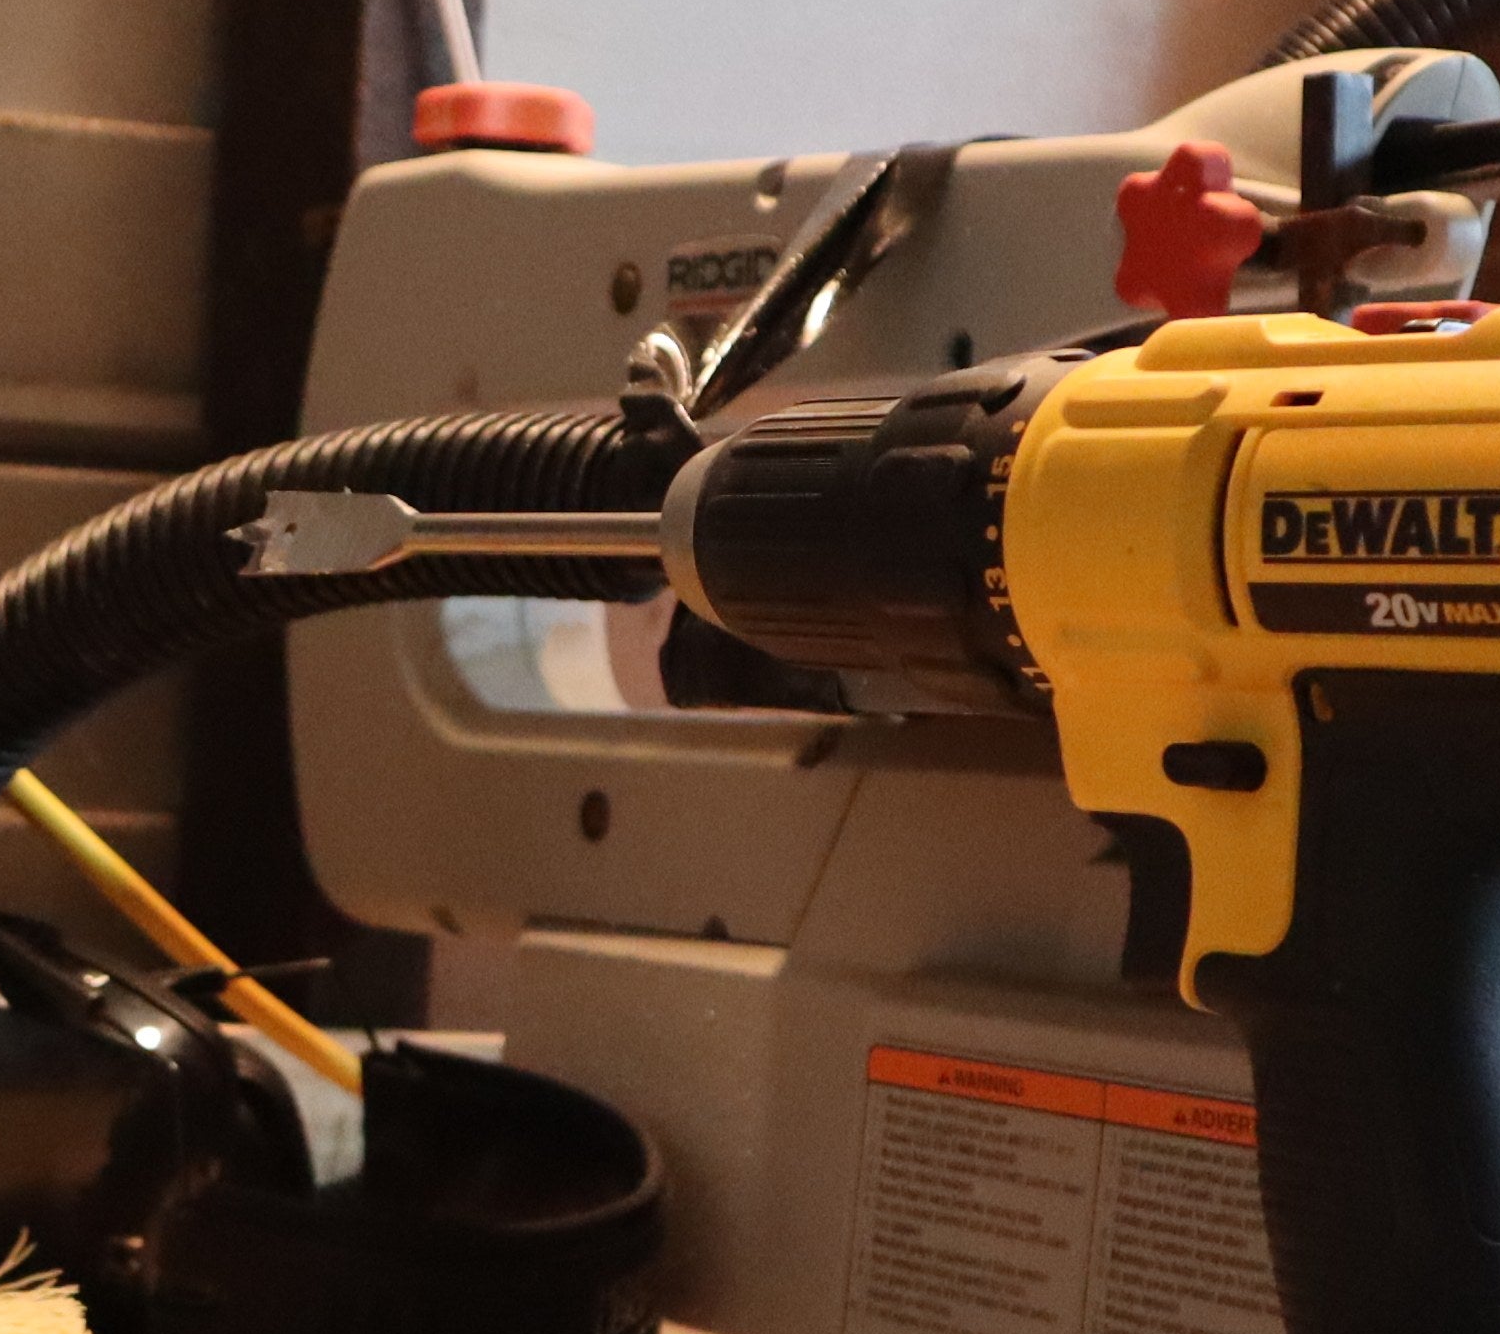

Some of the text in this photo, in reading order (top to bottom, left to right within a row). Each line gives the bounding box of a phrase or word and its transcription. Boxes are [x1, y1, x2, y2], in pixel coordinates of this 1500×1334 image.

[986, 454, 1015, 499] 15
[985, 566, 1010, 612] 13
[953, 1069, 1025, 1099] WARNING
[1190, 1107, 1256, 1135] ADVER
